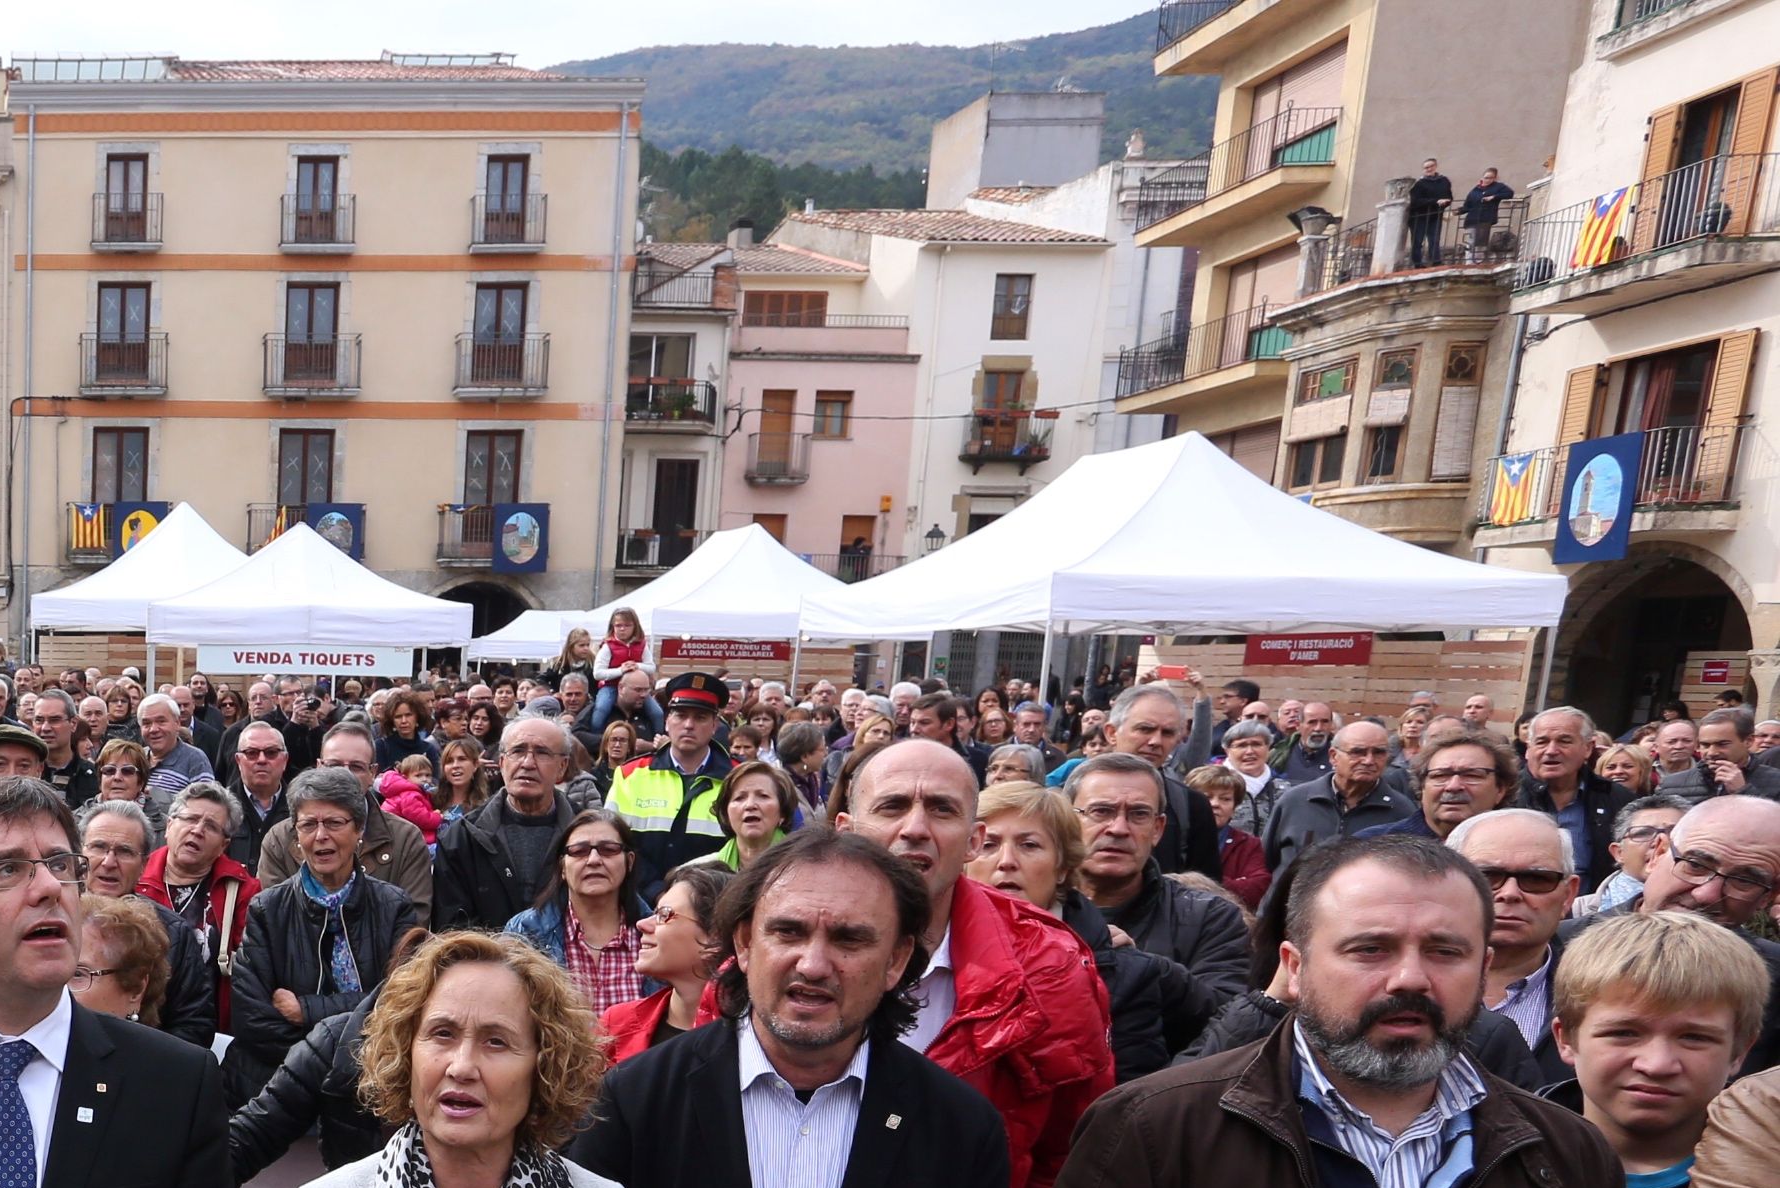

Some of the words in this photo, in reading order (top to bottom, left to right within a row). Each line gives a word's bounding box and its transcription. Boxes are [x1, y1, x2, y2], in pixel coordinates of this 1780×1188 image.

[681, 642, 728, 650] ASSOCIACIÓ
[730, 643, 760, 651] ATENEU
[761, 643, 772, 651] DE
[1297, 636, 1354, 649] RESTAURACIÓ
[689, 649, 711, 657] DONA
[233, 651, 293, 664] VENDA
[298, 652, 376, 667] TIQUETS
